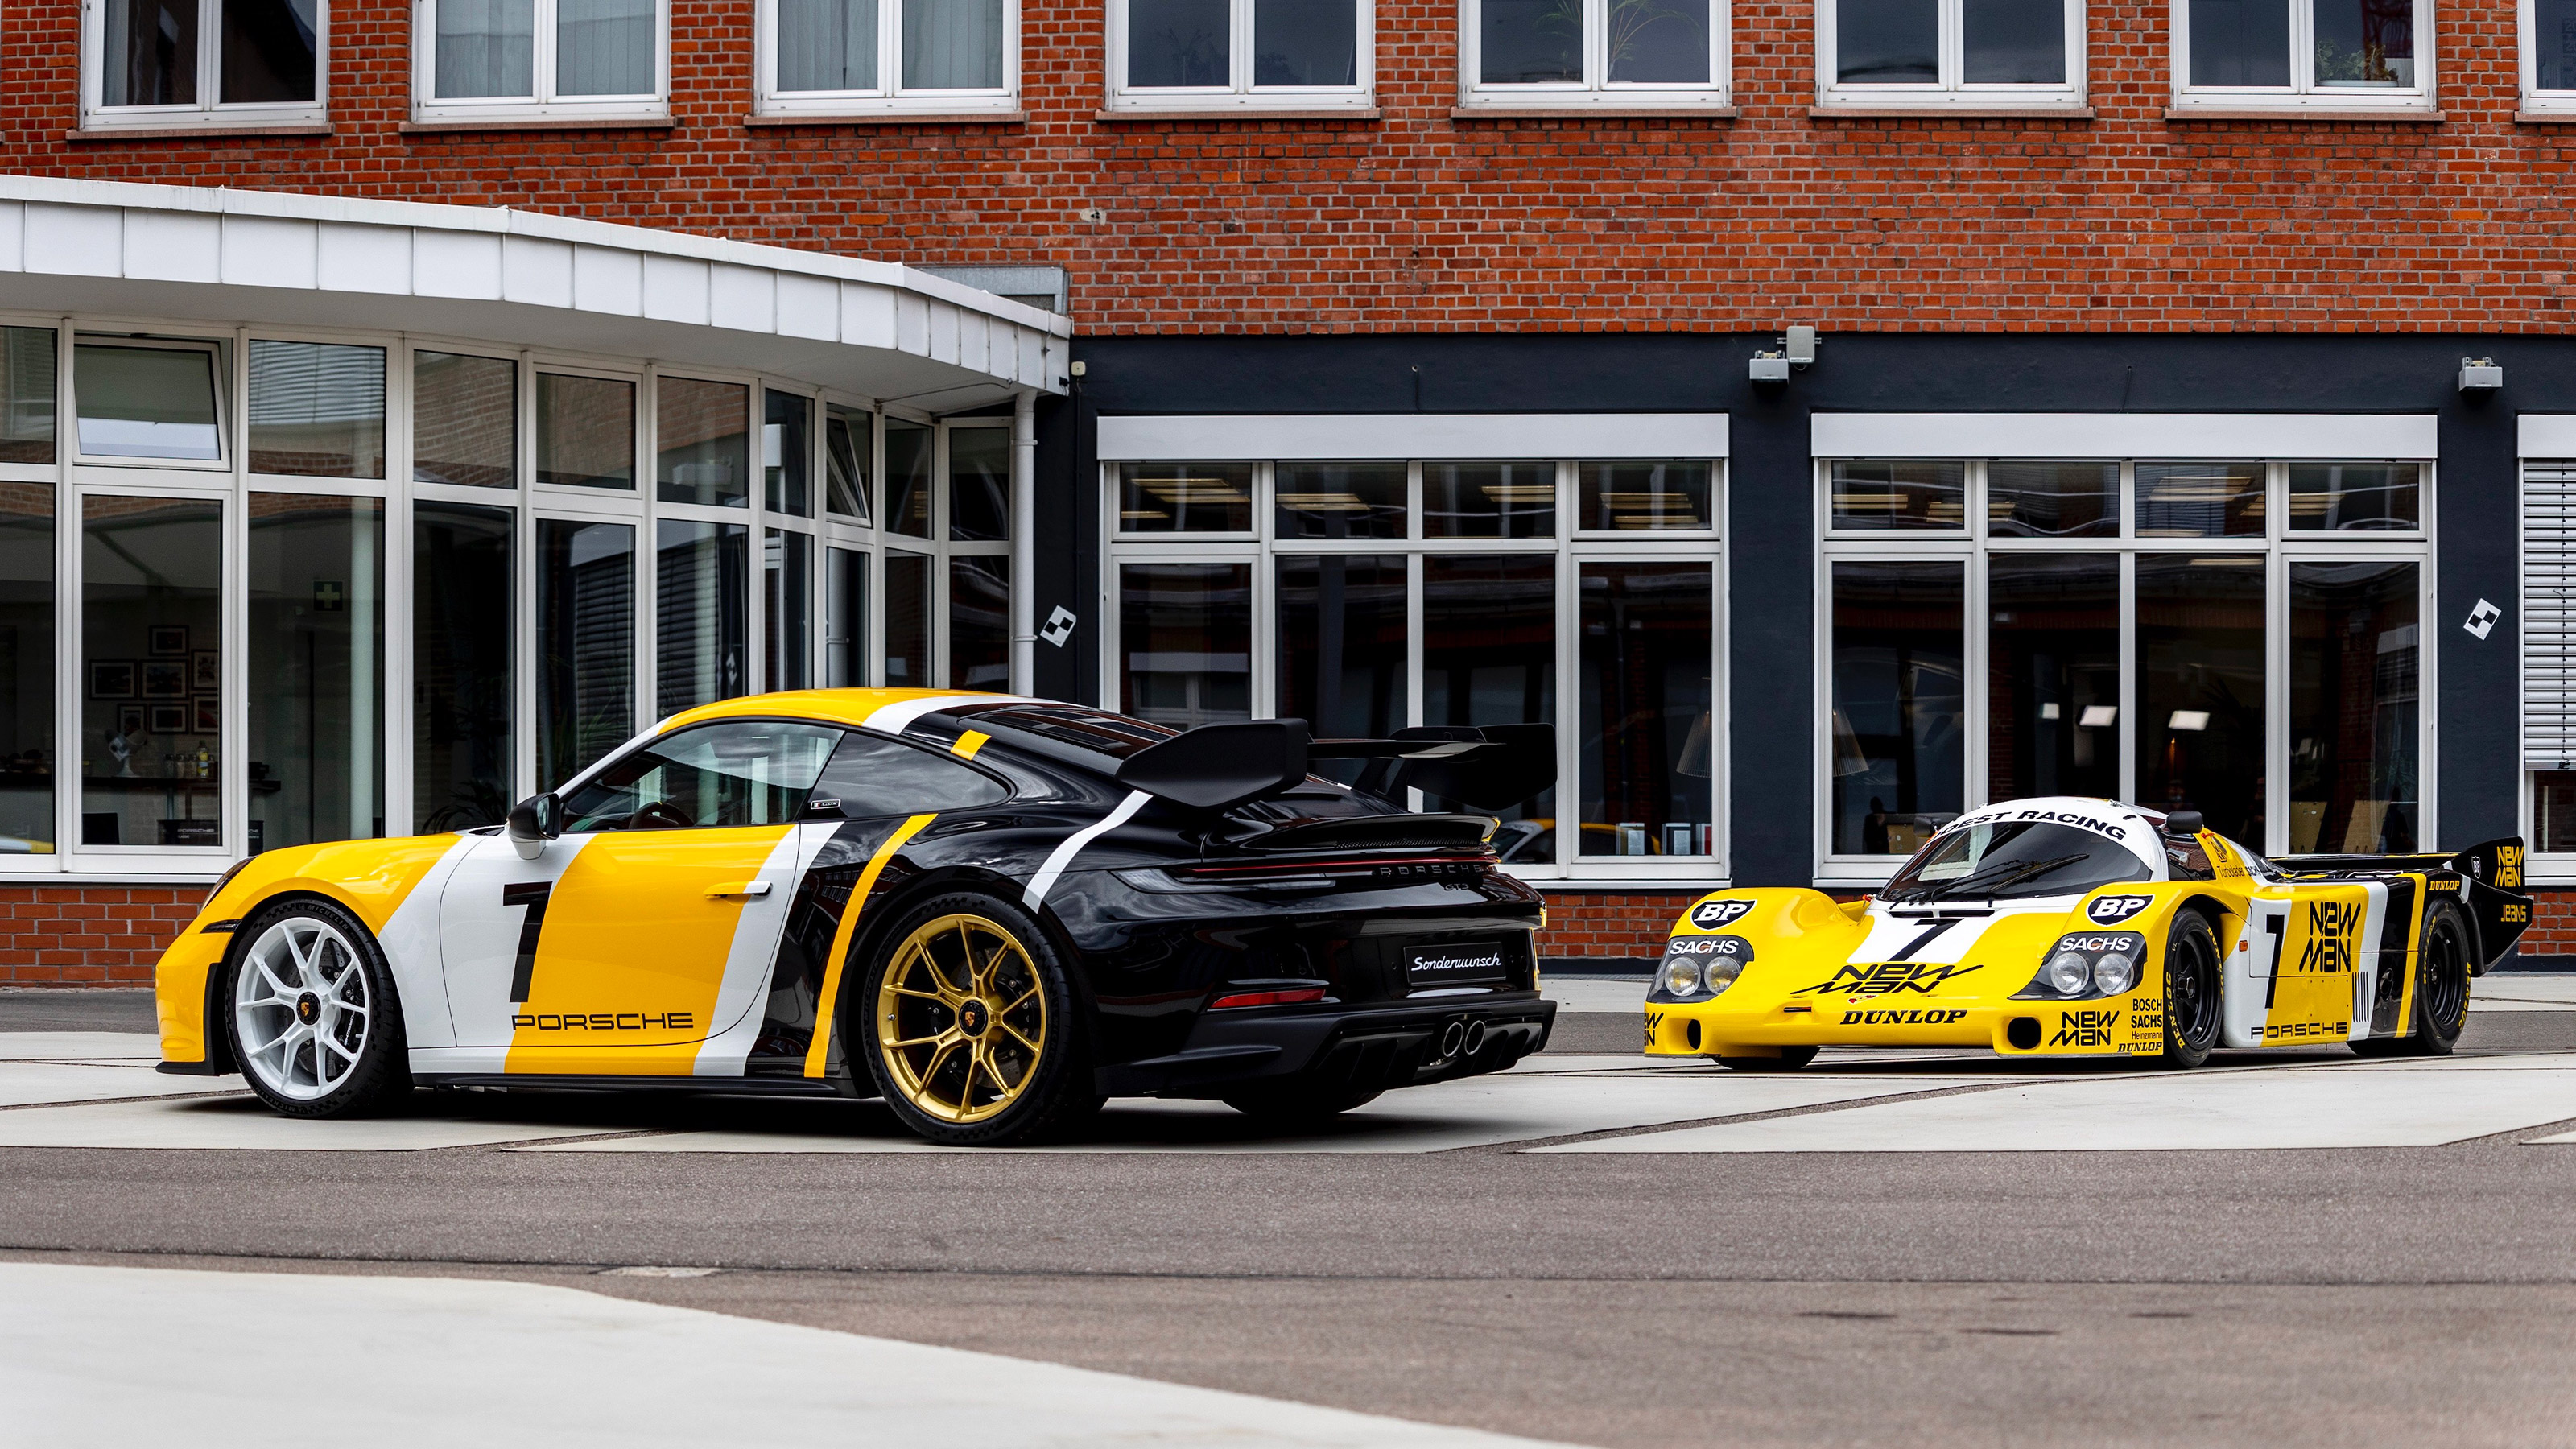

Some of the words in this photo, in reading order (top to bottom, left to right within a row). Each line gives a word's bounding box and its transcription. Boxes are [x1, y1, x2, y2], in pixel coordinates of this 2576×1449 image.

[2017, 811, 2127, 840] RACING
[1380, 864, 1482, 876] PORSCHE
[1443, 883, 1469, 891] GT3
[2429, 880, 2460, 891] DUNLOP
[1694, 903, 1748, 922] BP
[2090, 898, 2146, 917] BP
[307, 903, 349, 931] MICHELIN
[1670, 940, 1739, 955] SACHS
[1887, 918, 1965, 962] 7
[2060, 937, 2132, 952] SACHS
[1411, 952, 1501, 971] Sonderwunsch
[2132, 998, 2162, 1012] BOSCH
[2165, 972, 2186, 1049] DENLOC
[511, 1012, 694, 1031] PORSCHE
[1840, 1010, 1967, 1025] DUNLOP
[2131, 1014, 2162, 1028] SACHS
[2131, 1030, 2162, 1040] Heinzmann
[2251, 1022, 2347, 1040] PORSCHE
[2116, 1042, 2162, 1053] DUNLOP
